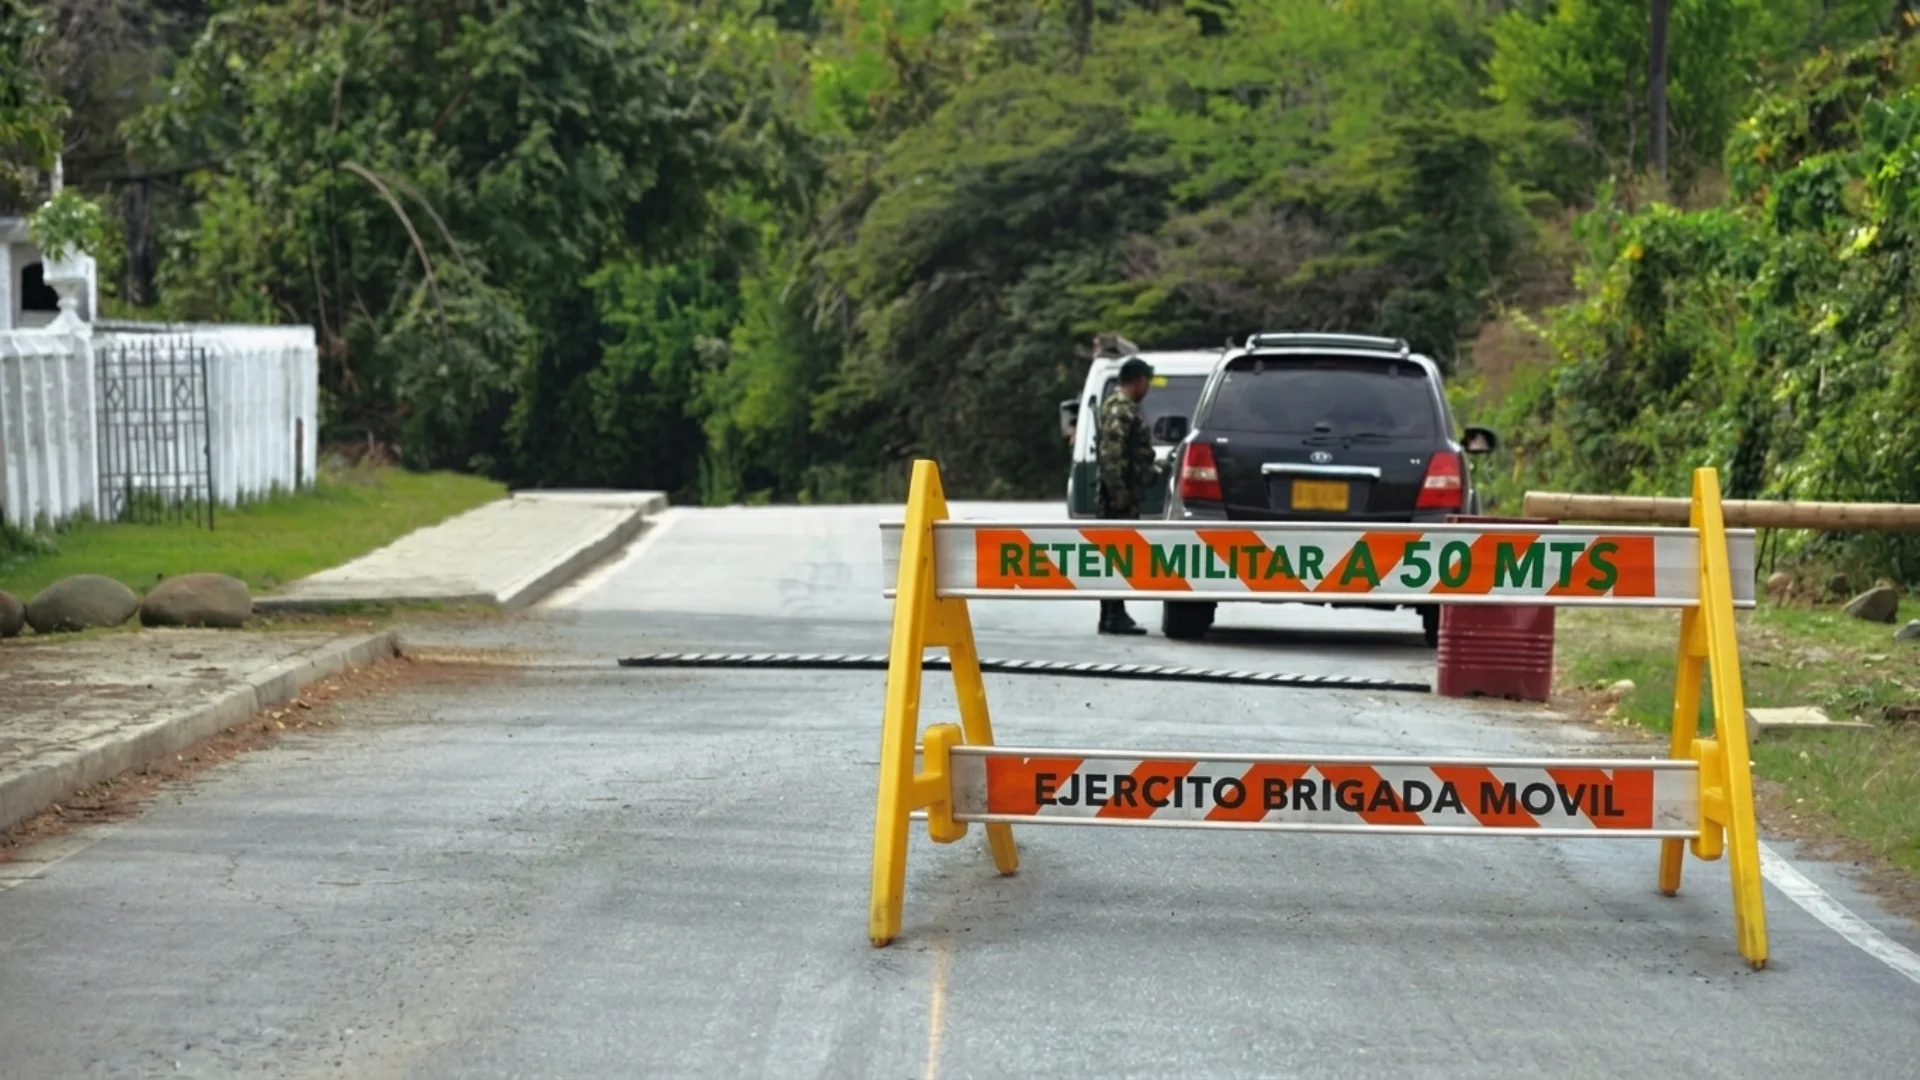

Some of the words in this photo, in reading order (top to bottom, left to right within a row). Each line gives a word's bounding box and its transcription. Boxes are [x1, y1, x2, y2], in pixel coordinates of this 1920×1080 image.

[1000, 543, 1133, 578] RETEN
[1150, 544, 1324, 580] MILITAR
[1339, 540, 1381, 587] A
[1400, 540, 1473, 589] 50
[1493, 542, 1620, 590] MTS
[1034, 773, 1247, 810] EJERCITO
[1263, 777, 1466, 815] BRIGADA
[1479, 781, 1625, 817] MOVIL
